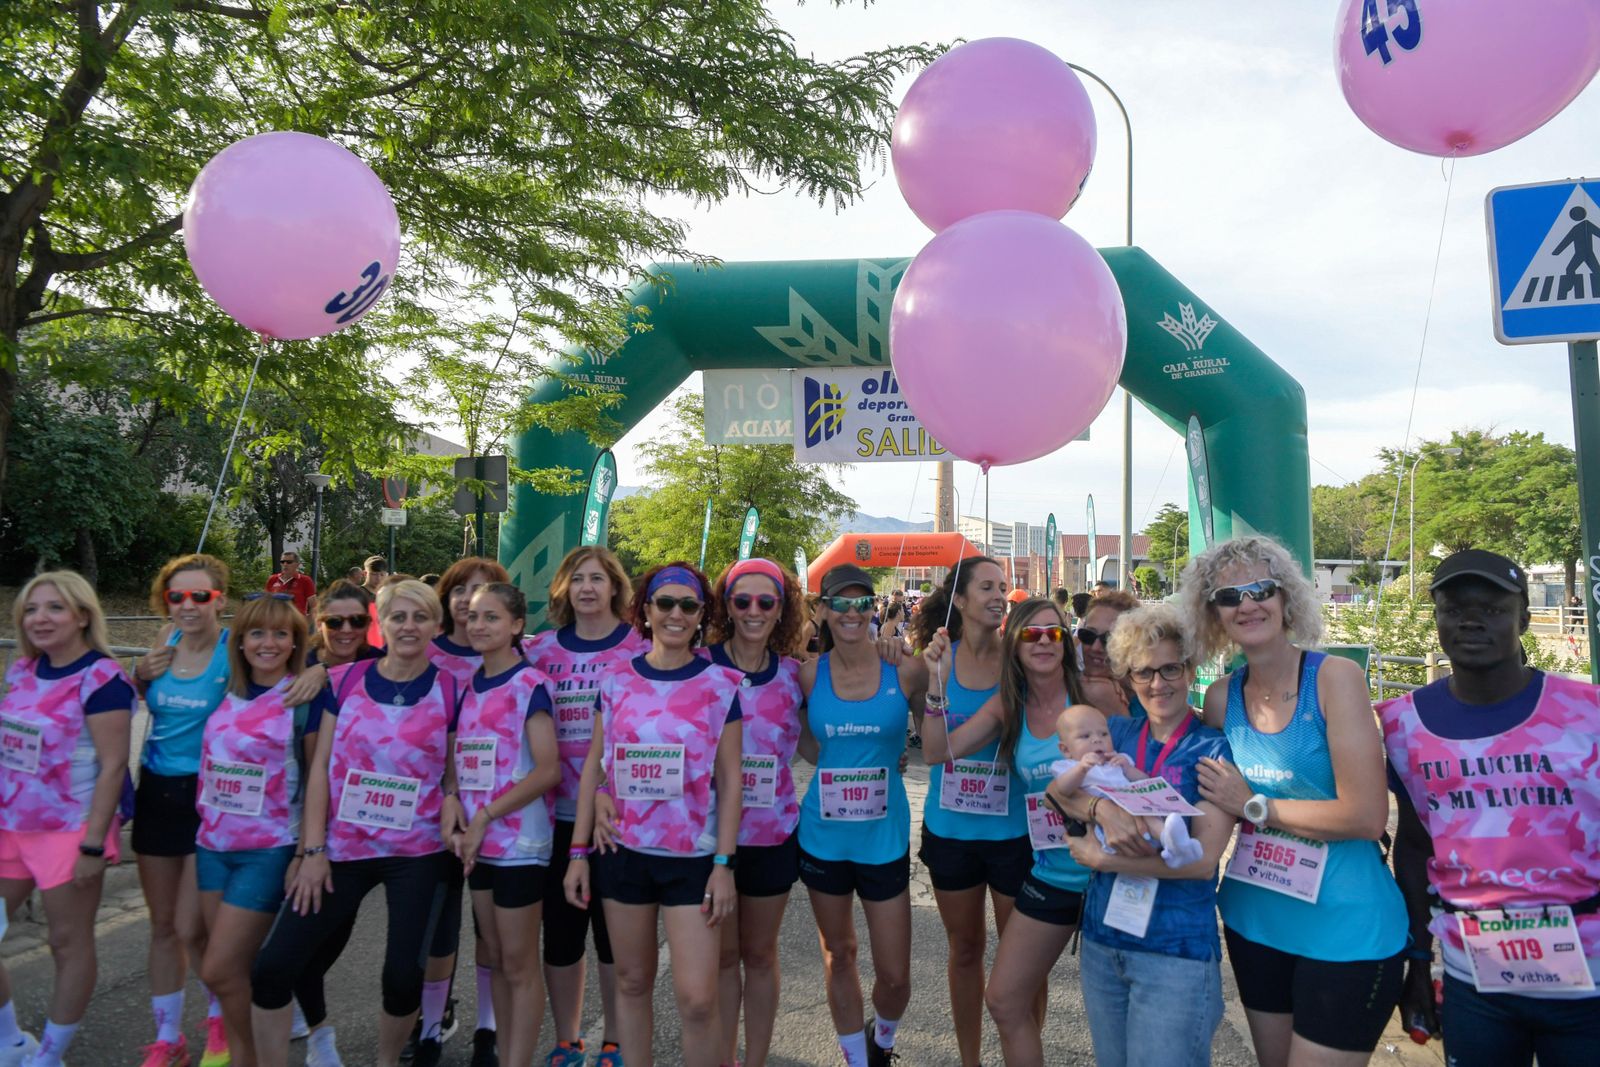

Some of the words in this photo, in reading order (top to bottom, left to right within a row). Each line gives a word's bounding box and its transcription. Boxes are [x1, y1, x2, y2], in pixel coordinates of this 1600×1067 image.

[1361, 0, 1421, 65] 45
[1163, 363, 1189, 374] CAJA
[1193, 358, 1230, 369] RURAL
[1184, 367, 1224, 377] GRANADA
[594, 375, 628, 384] RURAL
[559, 707, 590, 721] 8056
[837, 723, 880, 735] olimpo
[632, 763, 662, 778] 5012
[1245, 764, 1294, 782] olimpo
[1419, 760, 1450, 780] TU
[1460, 754, 1554, 777] LUCHA
[364, 790, 395, 808] 7410
[841, 787, 869, 801] 1197
[1448, 790, 1476, 809] MI
[1485, 786, 1575, 808] LUCHA
[1254, 841, 1296, 867] 5565
[1260, 871, 1292, 886] vithas
[1497, 938, 1544, 961] 1179
[1518, 973, 1561, 984] vithas
